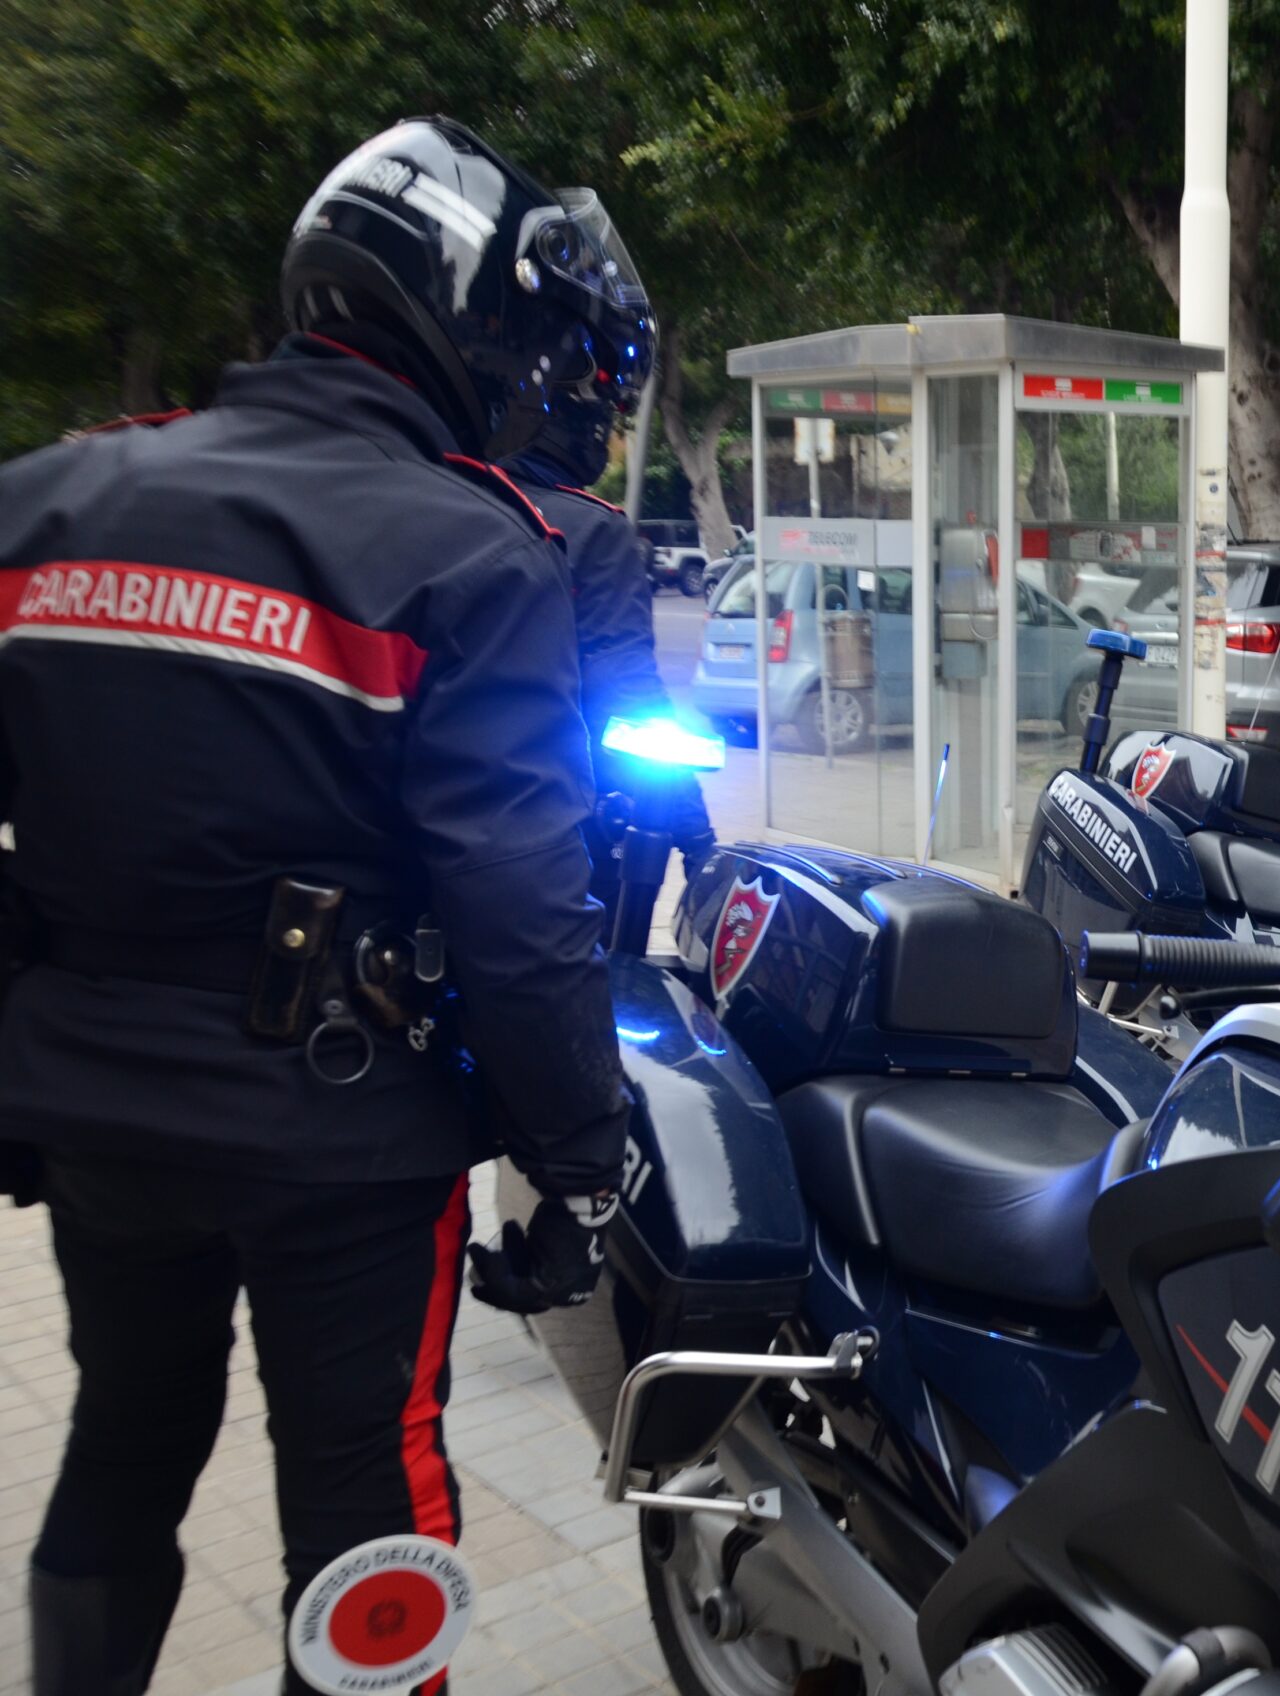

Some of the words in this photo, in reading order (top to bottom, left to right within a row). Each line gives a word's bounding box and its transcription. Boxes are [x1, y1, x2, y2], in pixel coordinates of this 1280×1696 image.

[16, 568, 311, 654] CARABINIERI
[1047, 774, 1138, 874] CARABINIERI
[300, 1555, 371, 1646] MINISTERO
[374, 1547, 437, 1567] DELLA
